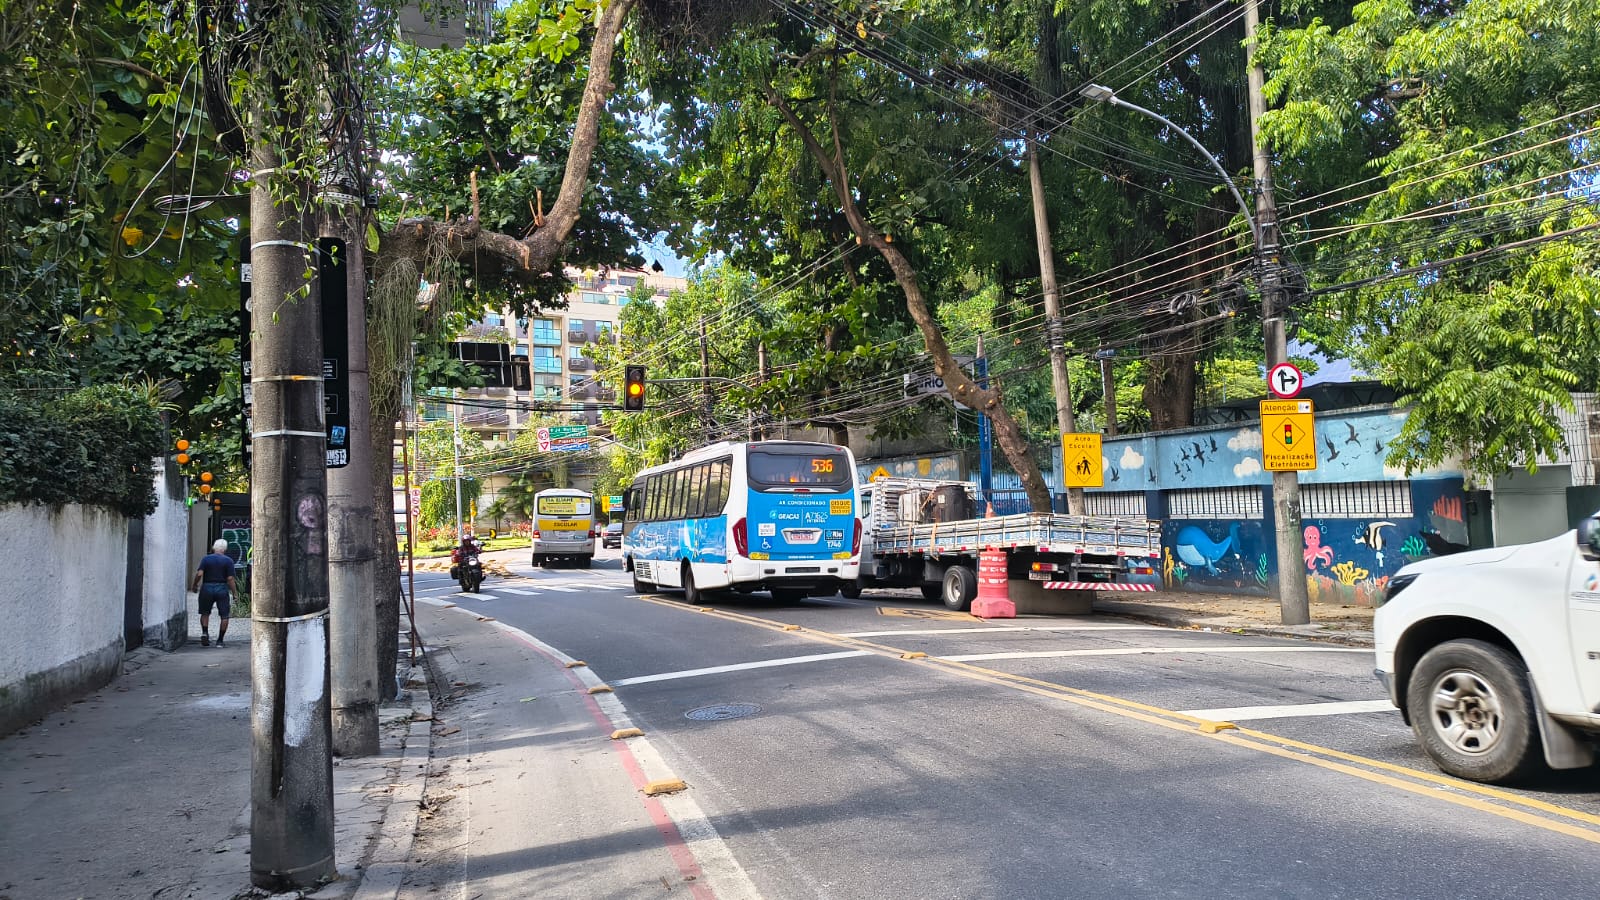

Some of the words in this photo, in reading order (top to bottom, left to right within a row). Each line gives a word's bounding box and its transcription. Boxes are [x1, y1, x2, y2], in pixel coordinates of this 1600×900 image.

[1264, 404, 1297, 412] Atenção
[1265, 453, 1314, 461] Fiscalização
[811, 459, 833, 473] 536
[827, 540, 842, 549] 1746
